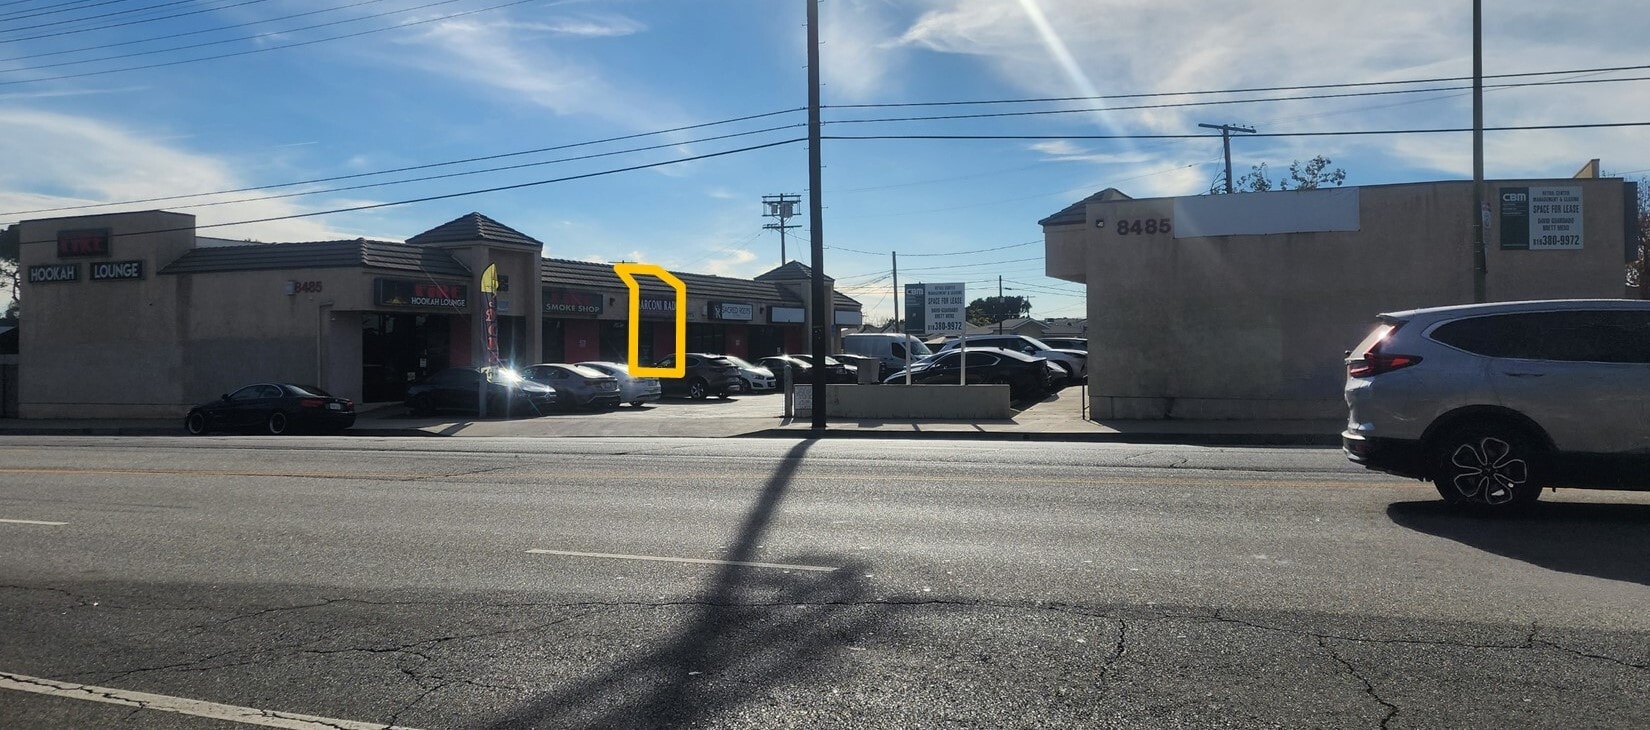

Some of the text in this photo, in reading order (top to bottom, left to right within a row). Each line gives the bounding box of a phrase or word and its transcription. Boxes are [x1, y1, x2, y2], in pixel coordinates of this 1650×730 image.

[1533, 204, 1549, 214] SPACE
[1551, 204, 1561, 214] FOR
[1563, 204, 1579, 214] LEASE
[1117, 218, 1171, 235] 8485
[31, 262, 139, 282] HOOKAH LOUNGE
[294, 281, 322, 293] 8485
[411, 296, 465, 307] HOOKAH LOUNGE
[639, 299, 662, 311] ARCONI
[928, 296, 940, 305] SPACE
[941, 296, 949, 305] FOR
[950, 296, 962, 305] LEASE
[546, 303, 600, 313] SMOKE SHOP
